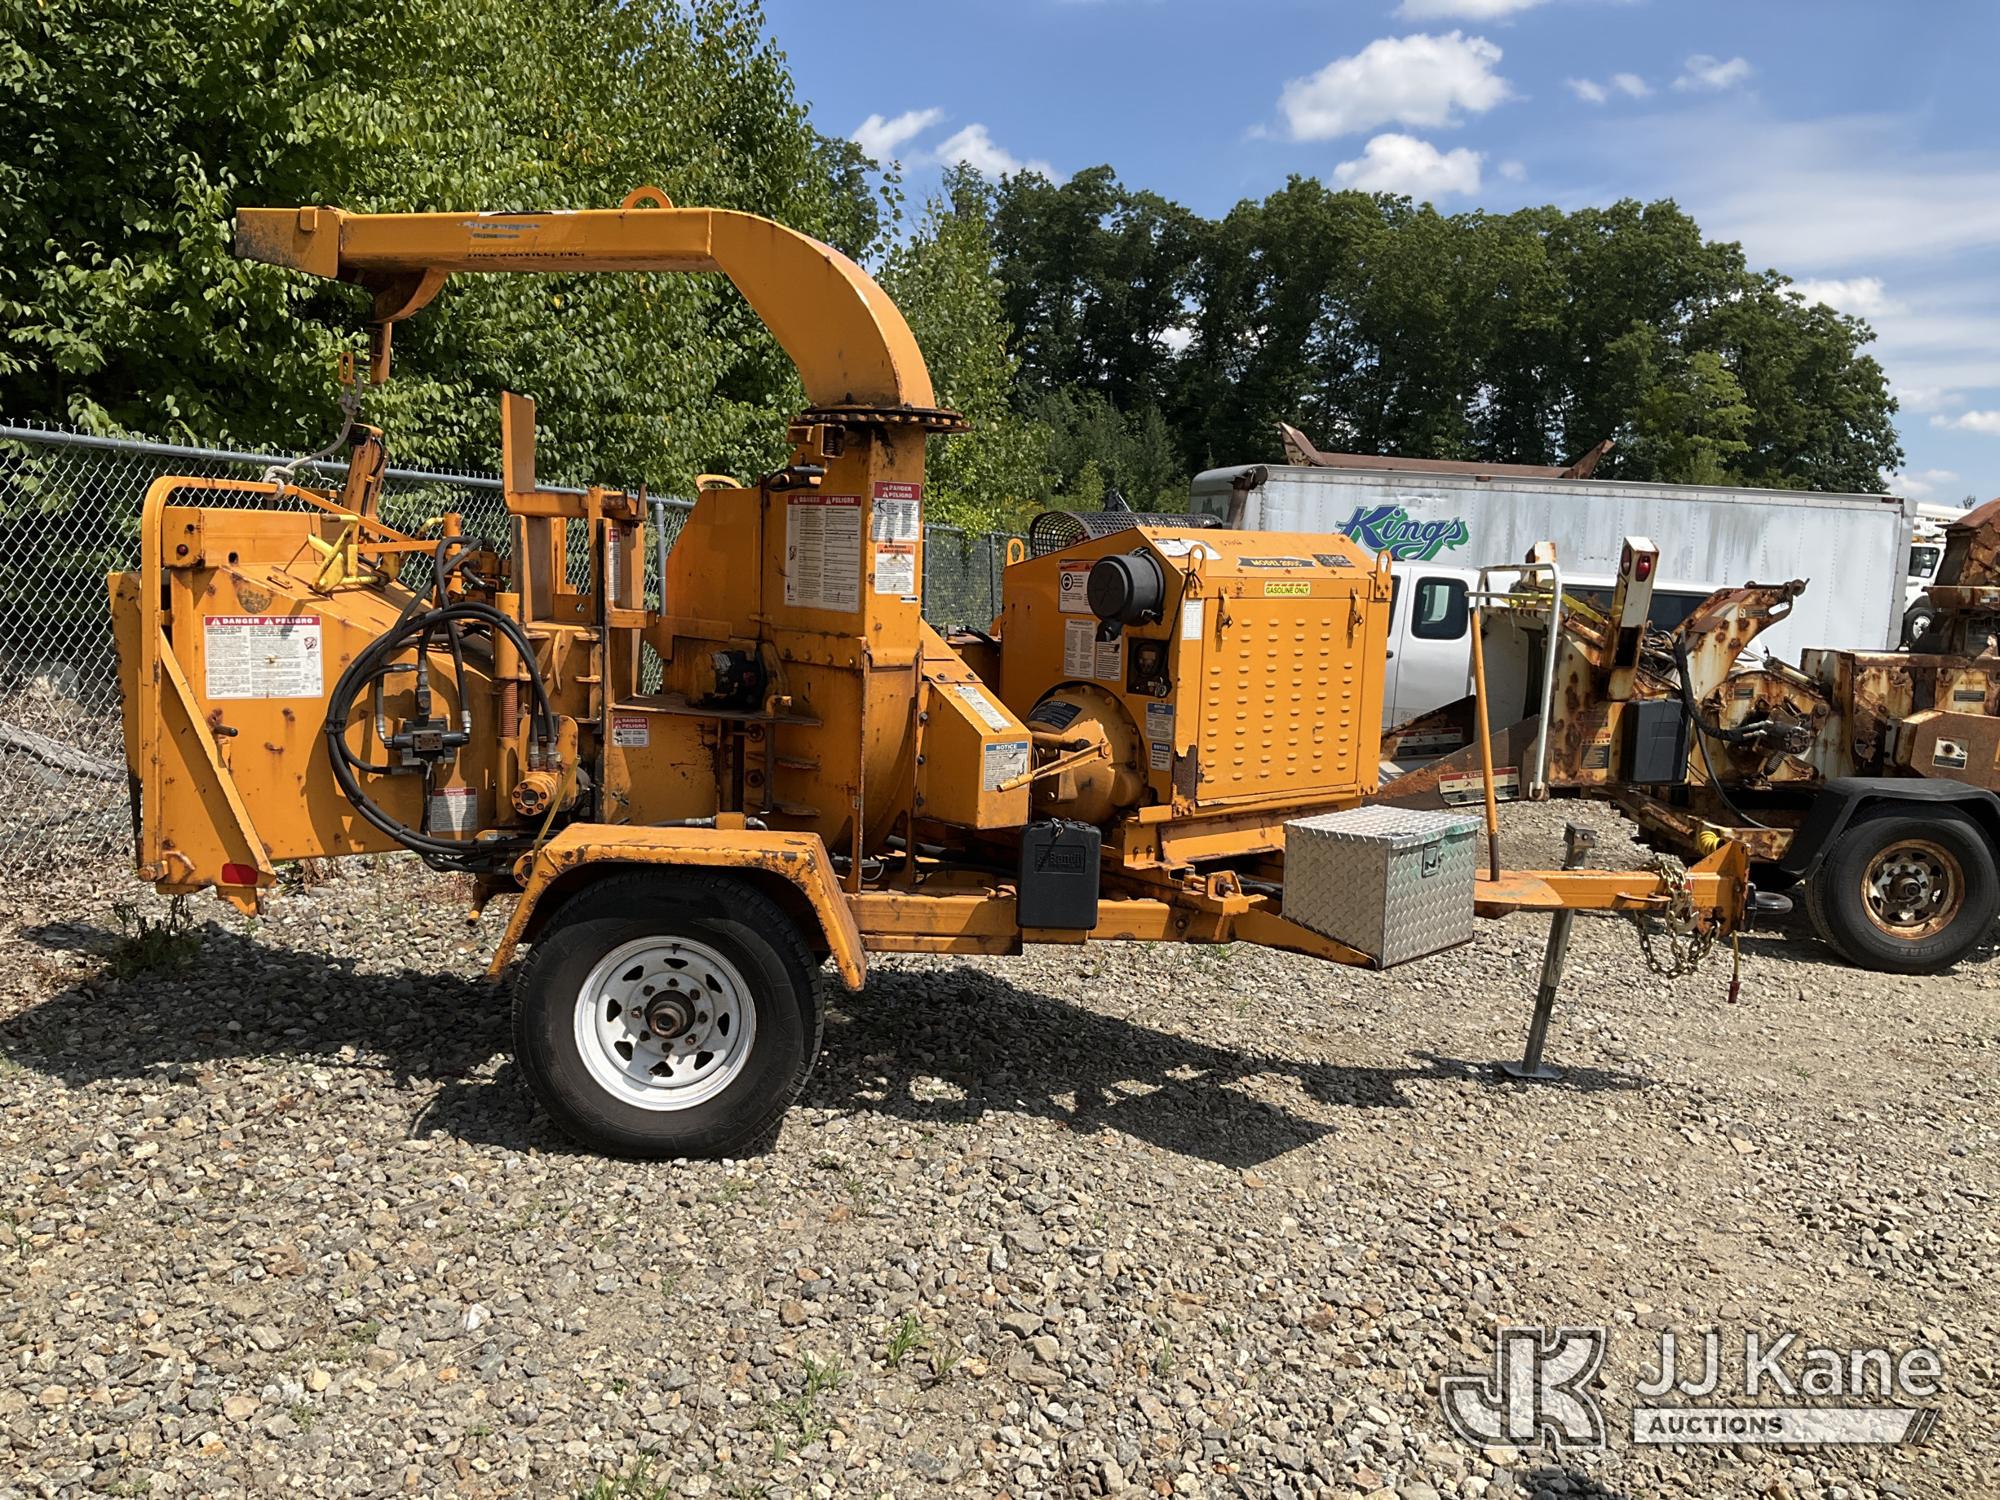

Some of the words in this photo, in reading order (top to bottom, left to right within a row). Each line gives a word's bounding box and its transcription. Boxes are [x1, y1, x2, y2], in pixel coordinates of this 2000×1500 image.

[1335, 504, 1469, 561] Kings
[1265, 586, 1293, 594] GASOLINE
[1294, 586, 1310, 594] ONLY
[222, 617, 260, 625] DANGER
[275, 617, 313, 625] PELIGRO
[996, 743, 1018, 751] NOTICE
